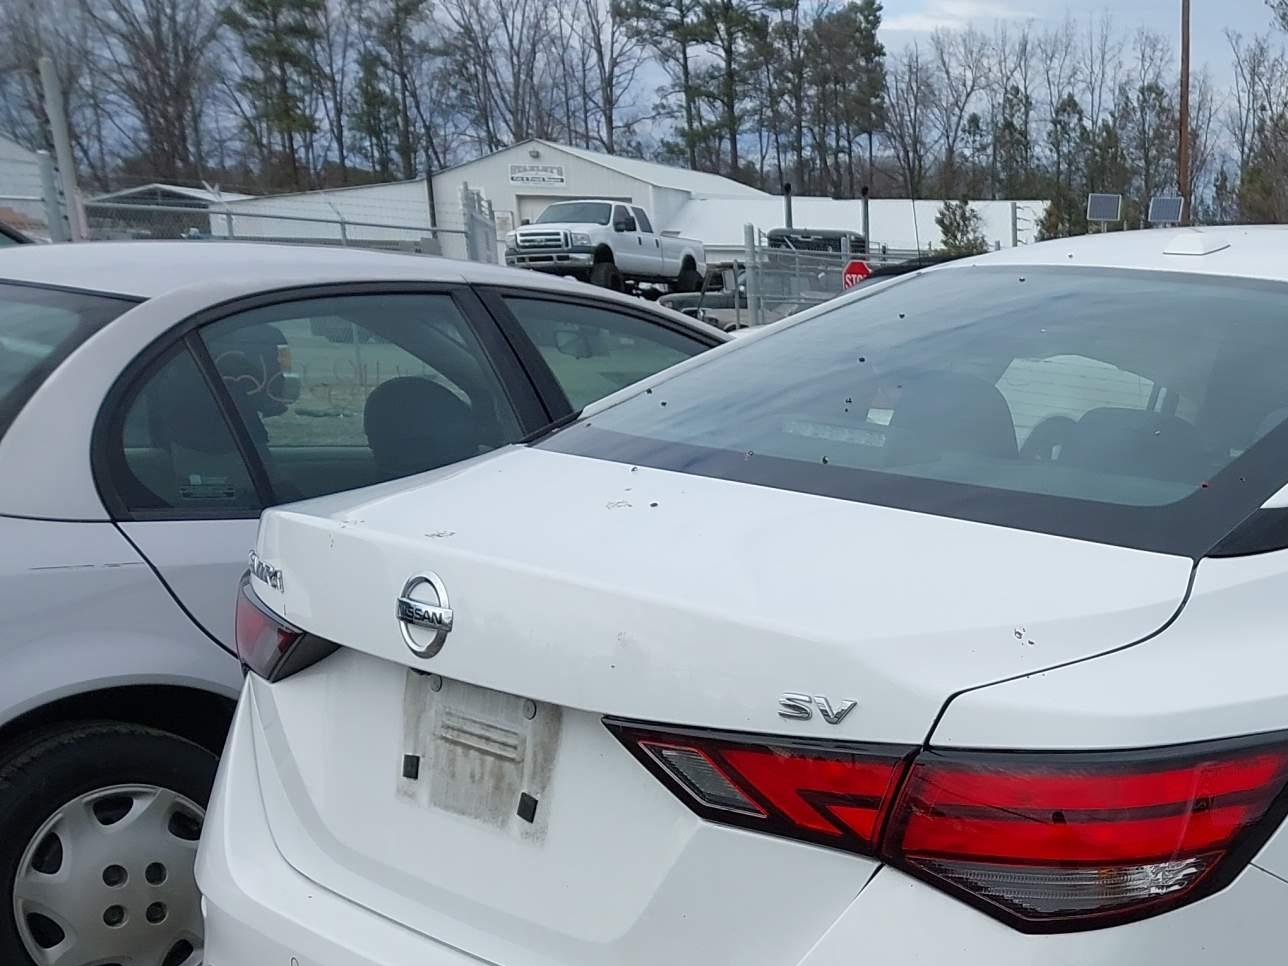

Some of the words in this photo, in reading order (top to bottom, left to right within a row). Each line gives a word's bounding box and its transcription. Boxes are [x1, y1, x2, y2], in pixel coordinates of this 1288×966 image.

[845, 273, 869, 289] STO
[398, 602, 443, 625] NISSAN
[777, 691, 858, 725] SV
